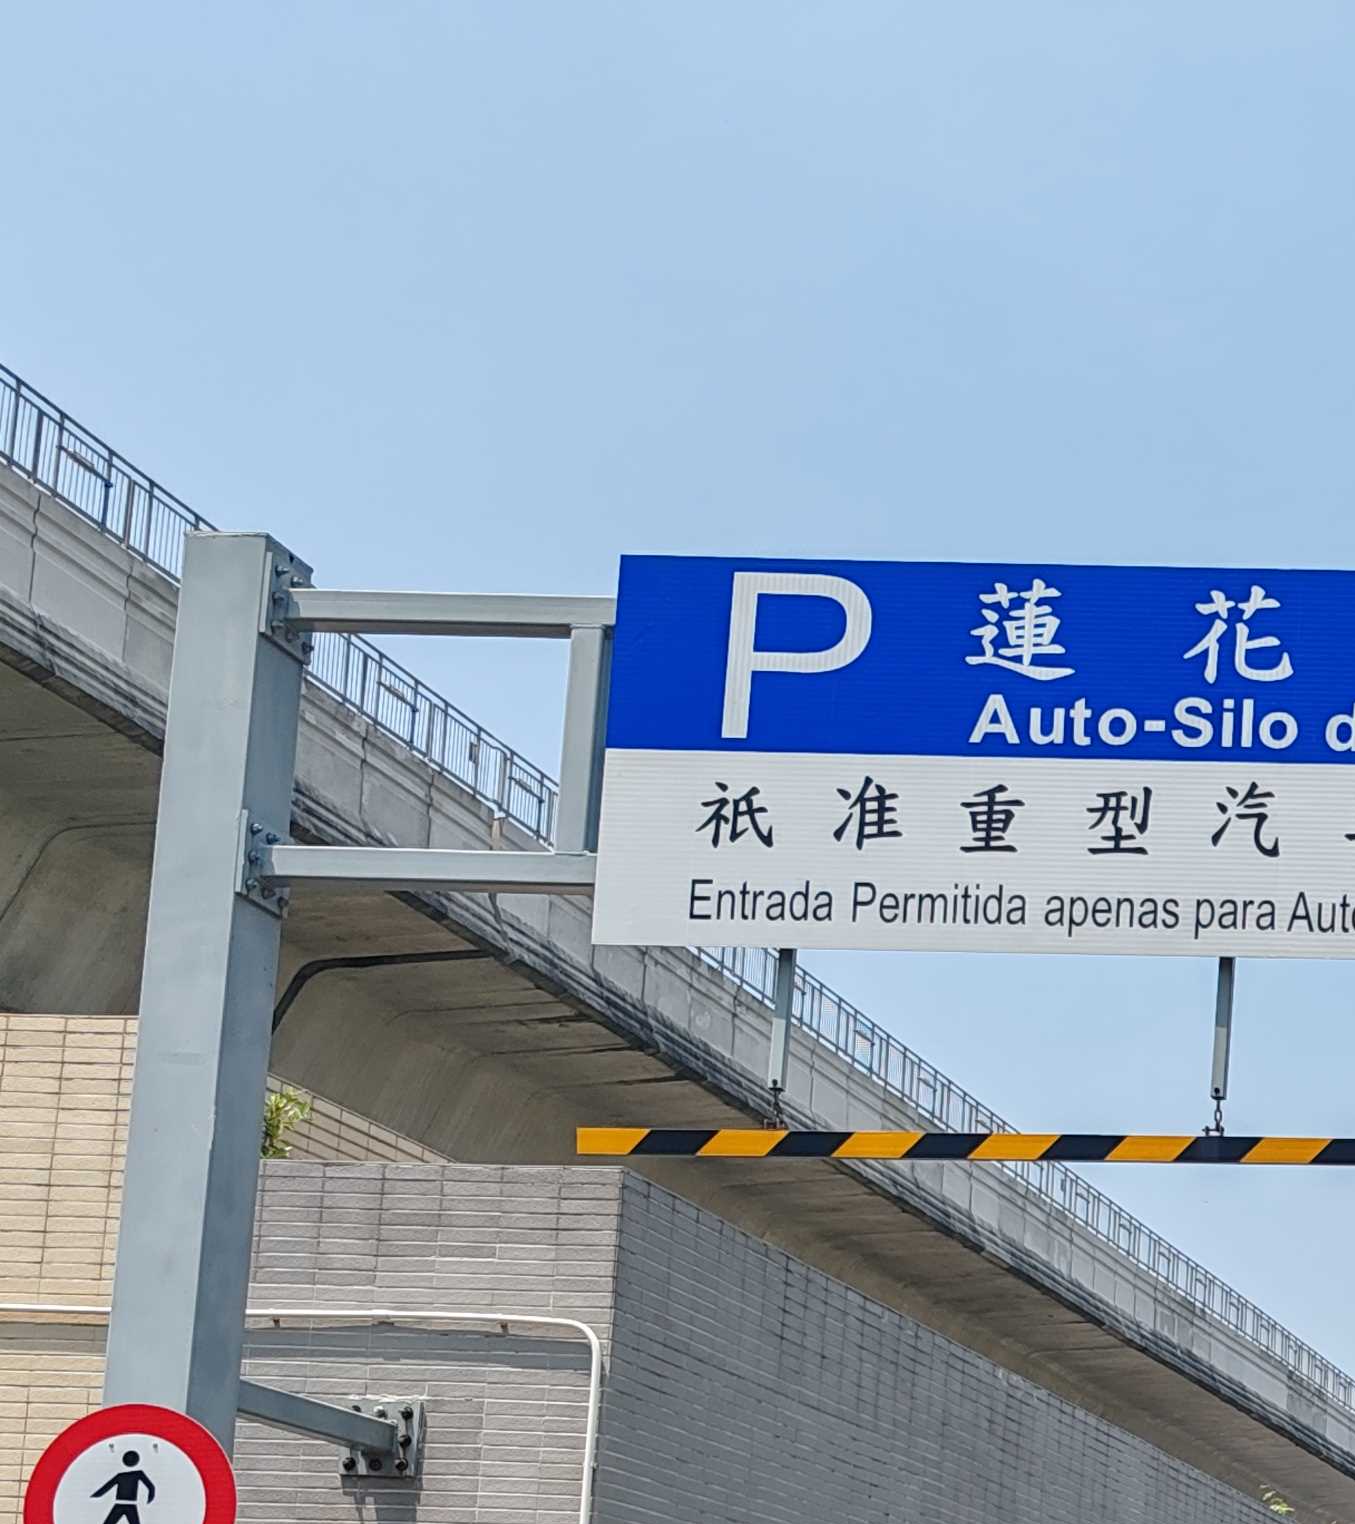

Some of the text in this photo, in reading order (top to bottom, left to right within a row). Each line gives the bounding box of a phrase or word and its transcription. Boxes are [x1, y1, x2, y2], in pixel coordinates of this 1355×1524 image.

[721, 571, 873, 739] P
[968, 694, 1299, 750] Auto-Silo
[688, 879, 833, 922] Entrada
[852, 882, 1027, 925] Permitida
[1044, 896, 1179, 937] apenas
[1194, 898, 1276, 939] para
